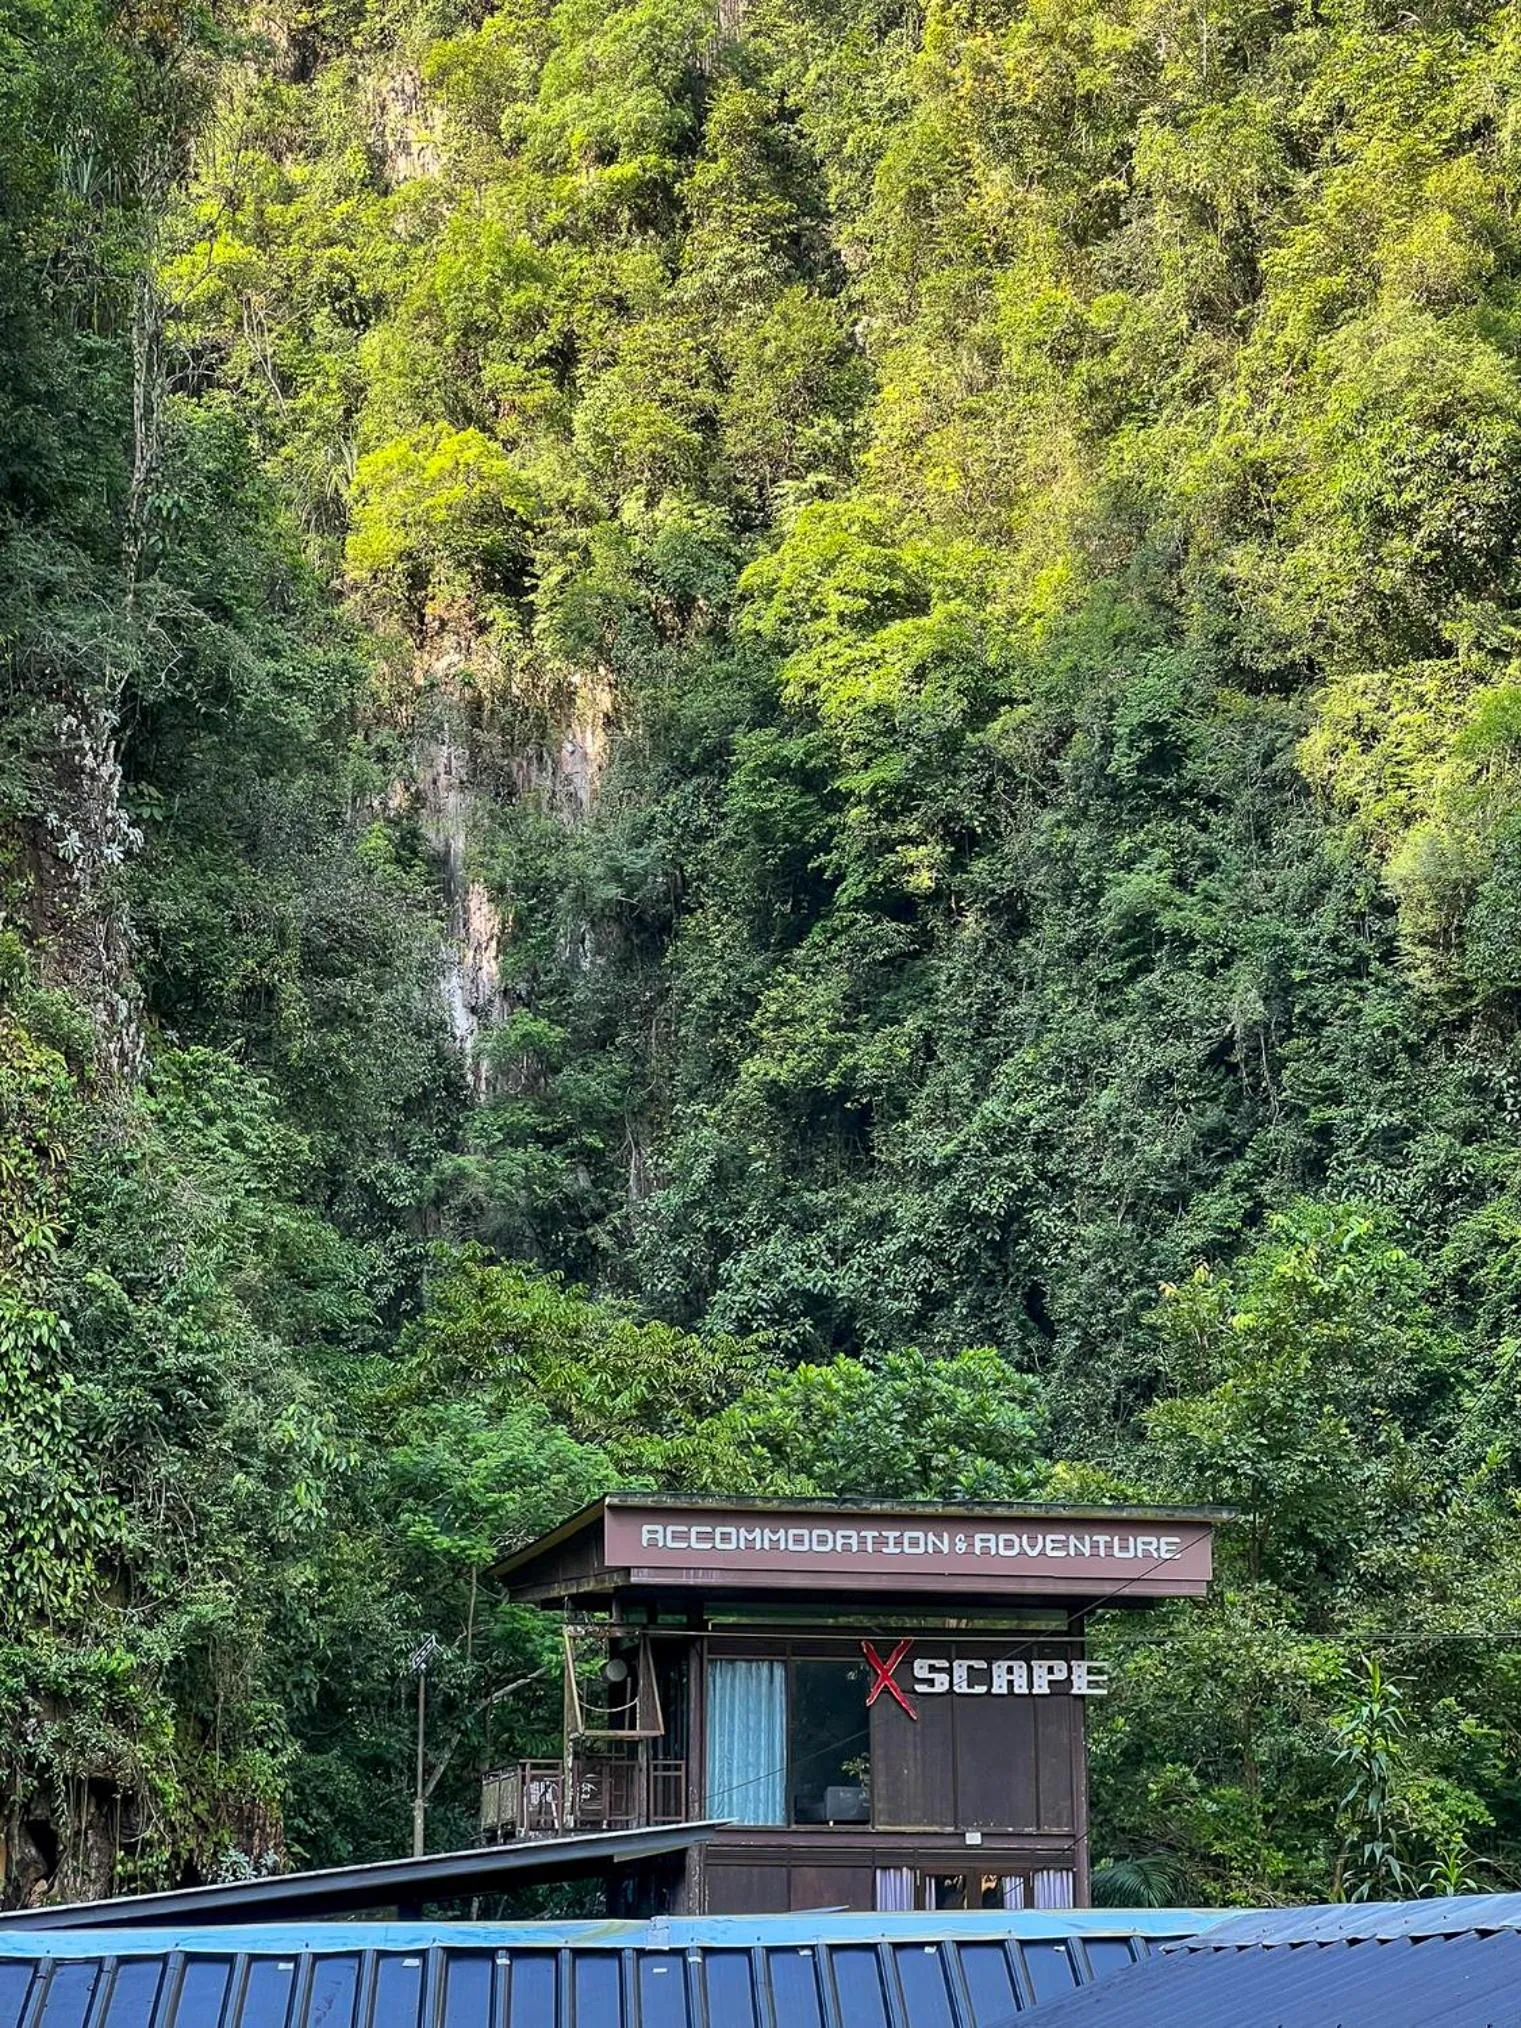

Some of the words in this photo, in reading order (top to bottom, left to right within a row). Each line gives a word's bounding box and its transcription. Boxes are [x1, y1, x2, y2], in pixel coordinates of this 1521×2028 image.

[641, 1524, 950, 1555] ACCOMMODATION
[954, 1533, 968, 1554] &
[973, 1533, 1182, 1560] ADVENTURE
